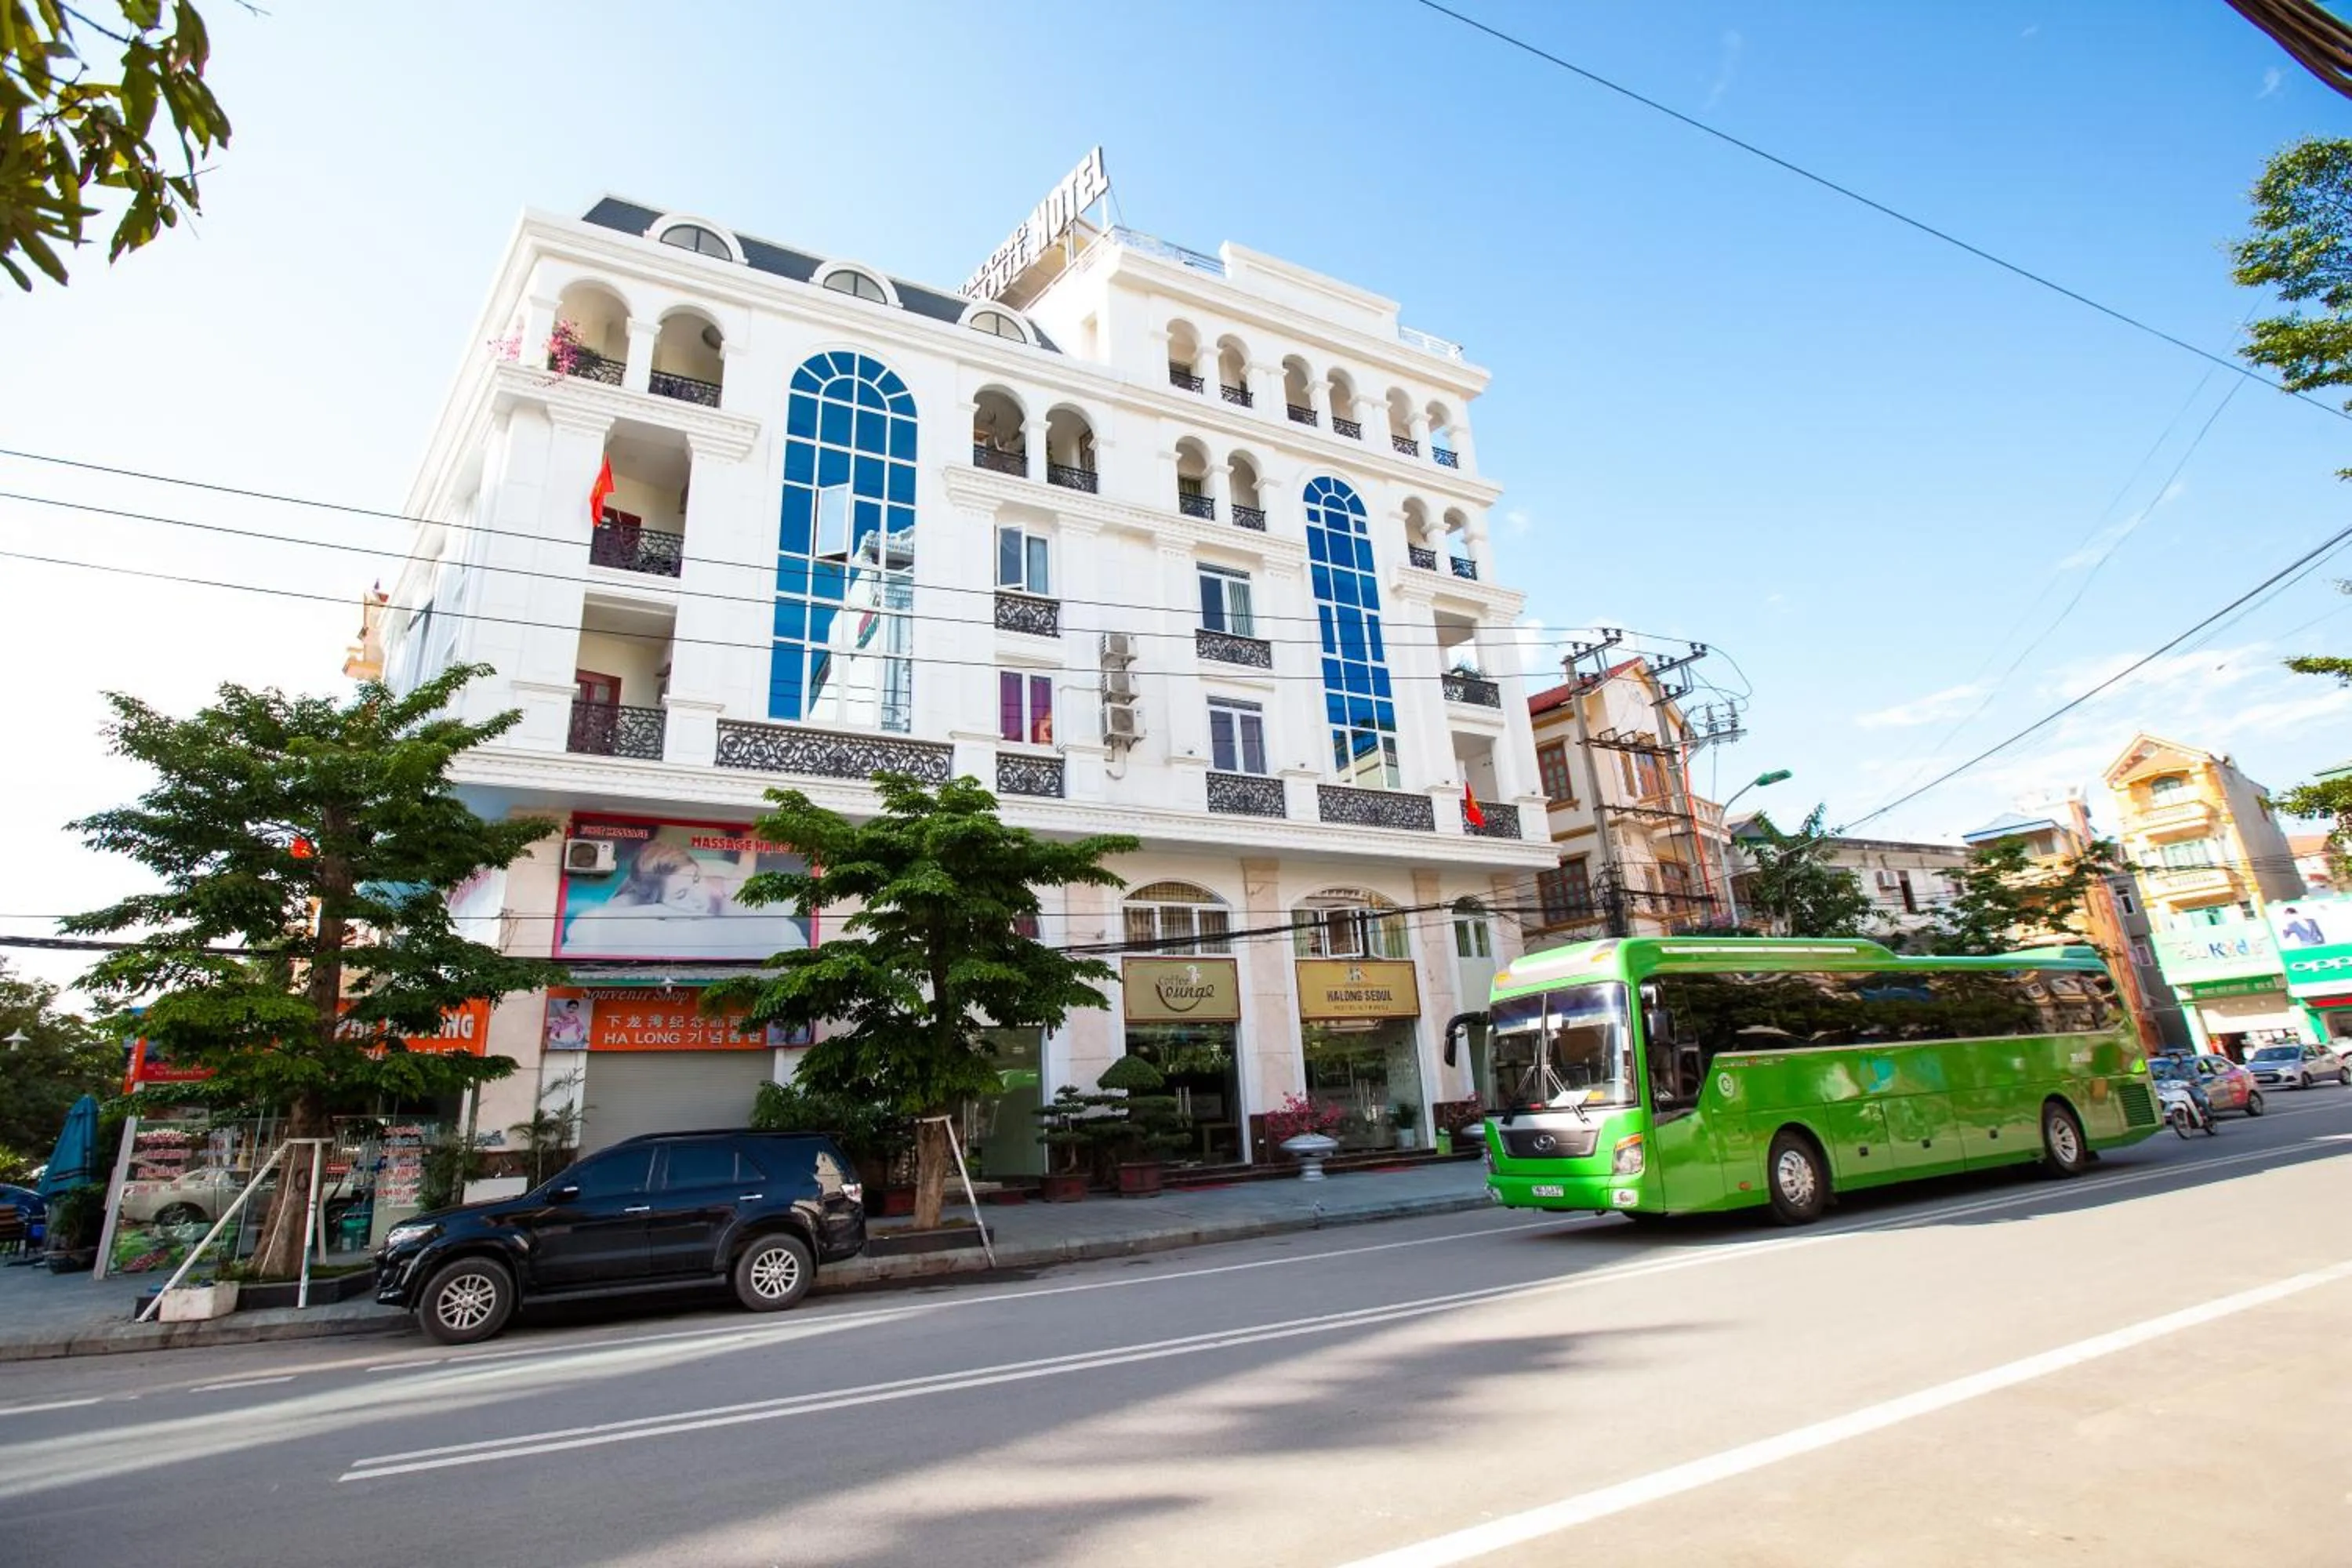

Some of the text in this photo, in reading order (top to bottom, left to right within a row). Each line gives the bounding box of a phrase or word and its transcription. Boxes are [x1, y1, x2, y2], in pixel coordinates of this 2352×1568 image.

[1032, 143, 1109, 256] HOTEL
[691, 835, 752, 851] MASSAGE
[583, 989, 689, 1006] Souvenir Shop
[1365, 989, 1393, 1000] SEOUL
[604, 1032, 628, 1044] HA
[635, 1032, 681, 1044] LONG
